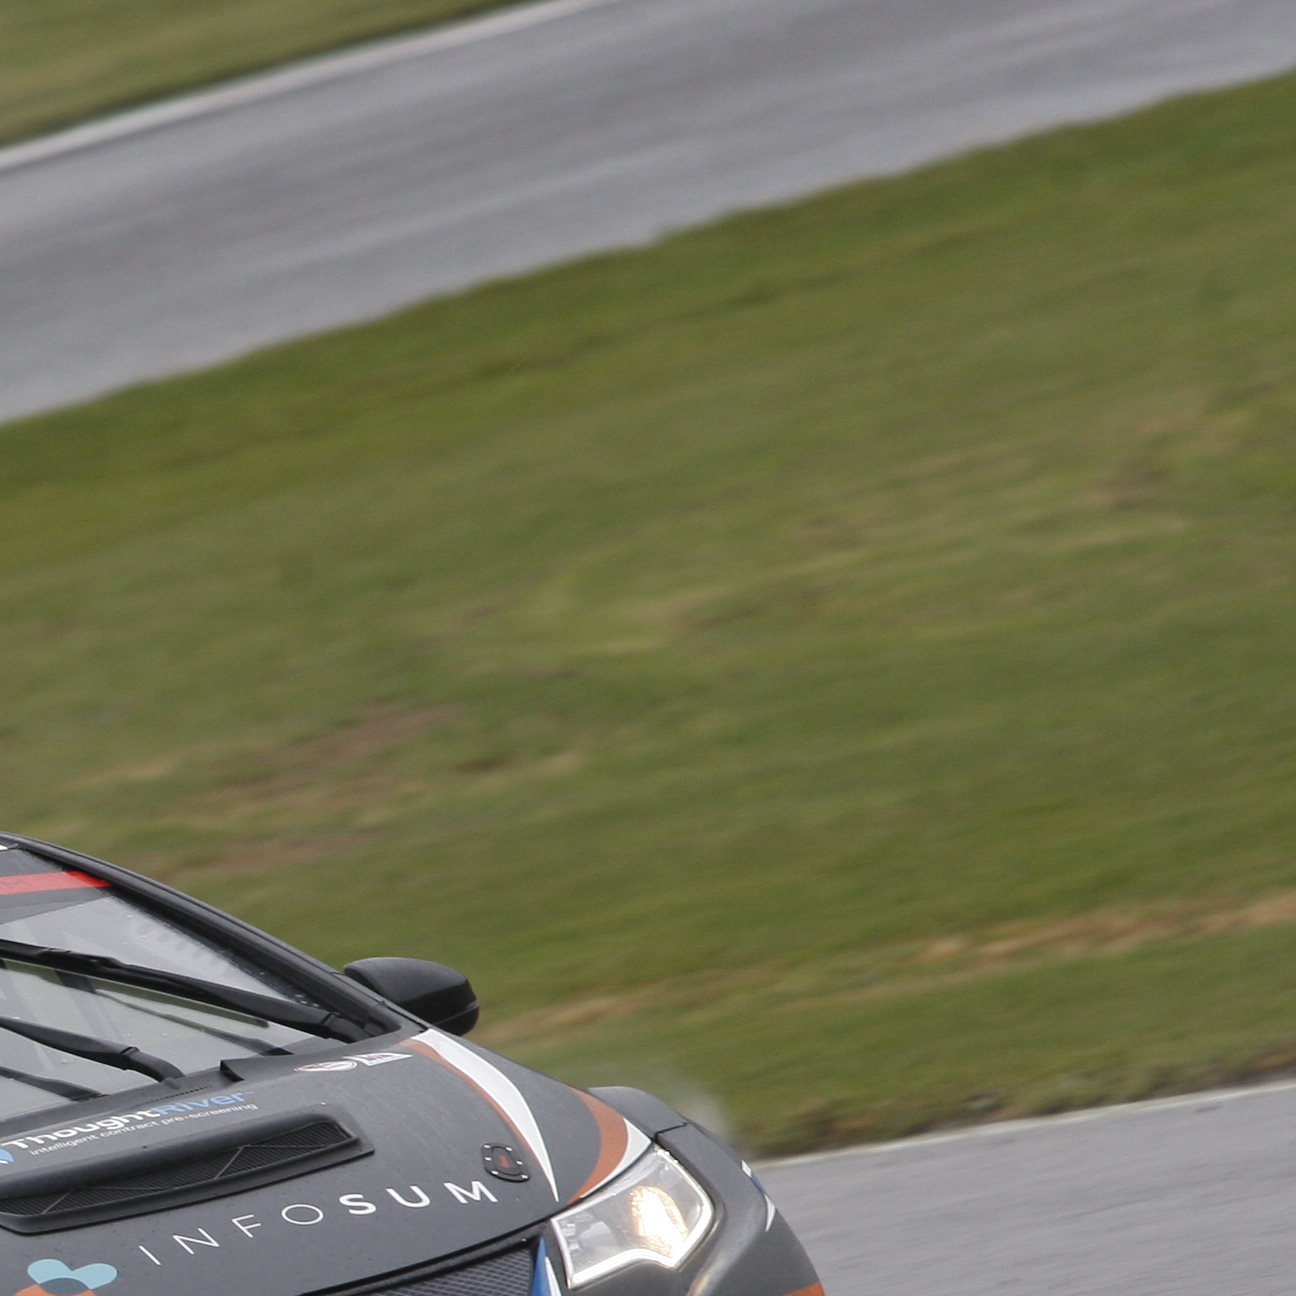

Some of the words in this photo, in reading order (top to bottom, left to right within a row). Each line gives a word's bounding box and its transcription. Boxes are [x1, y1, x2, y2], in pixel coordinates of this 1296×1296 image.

[29, 1134, 100, 1156] intelligent
[99, 1120, 160, 1137] contract
[161, 1103, 259, 1126] pre-screening
[138, 1180, 499, 1266] INFOSUM
